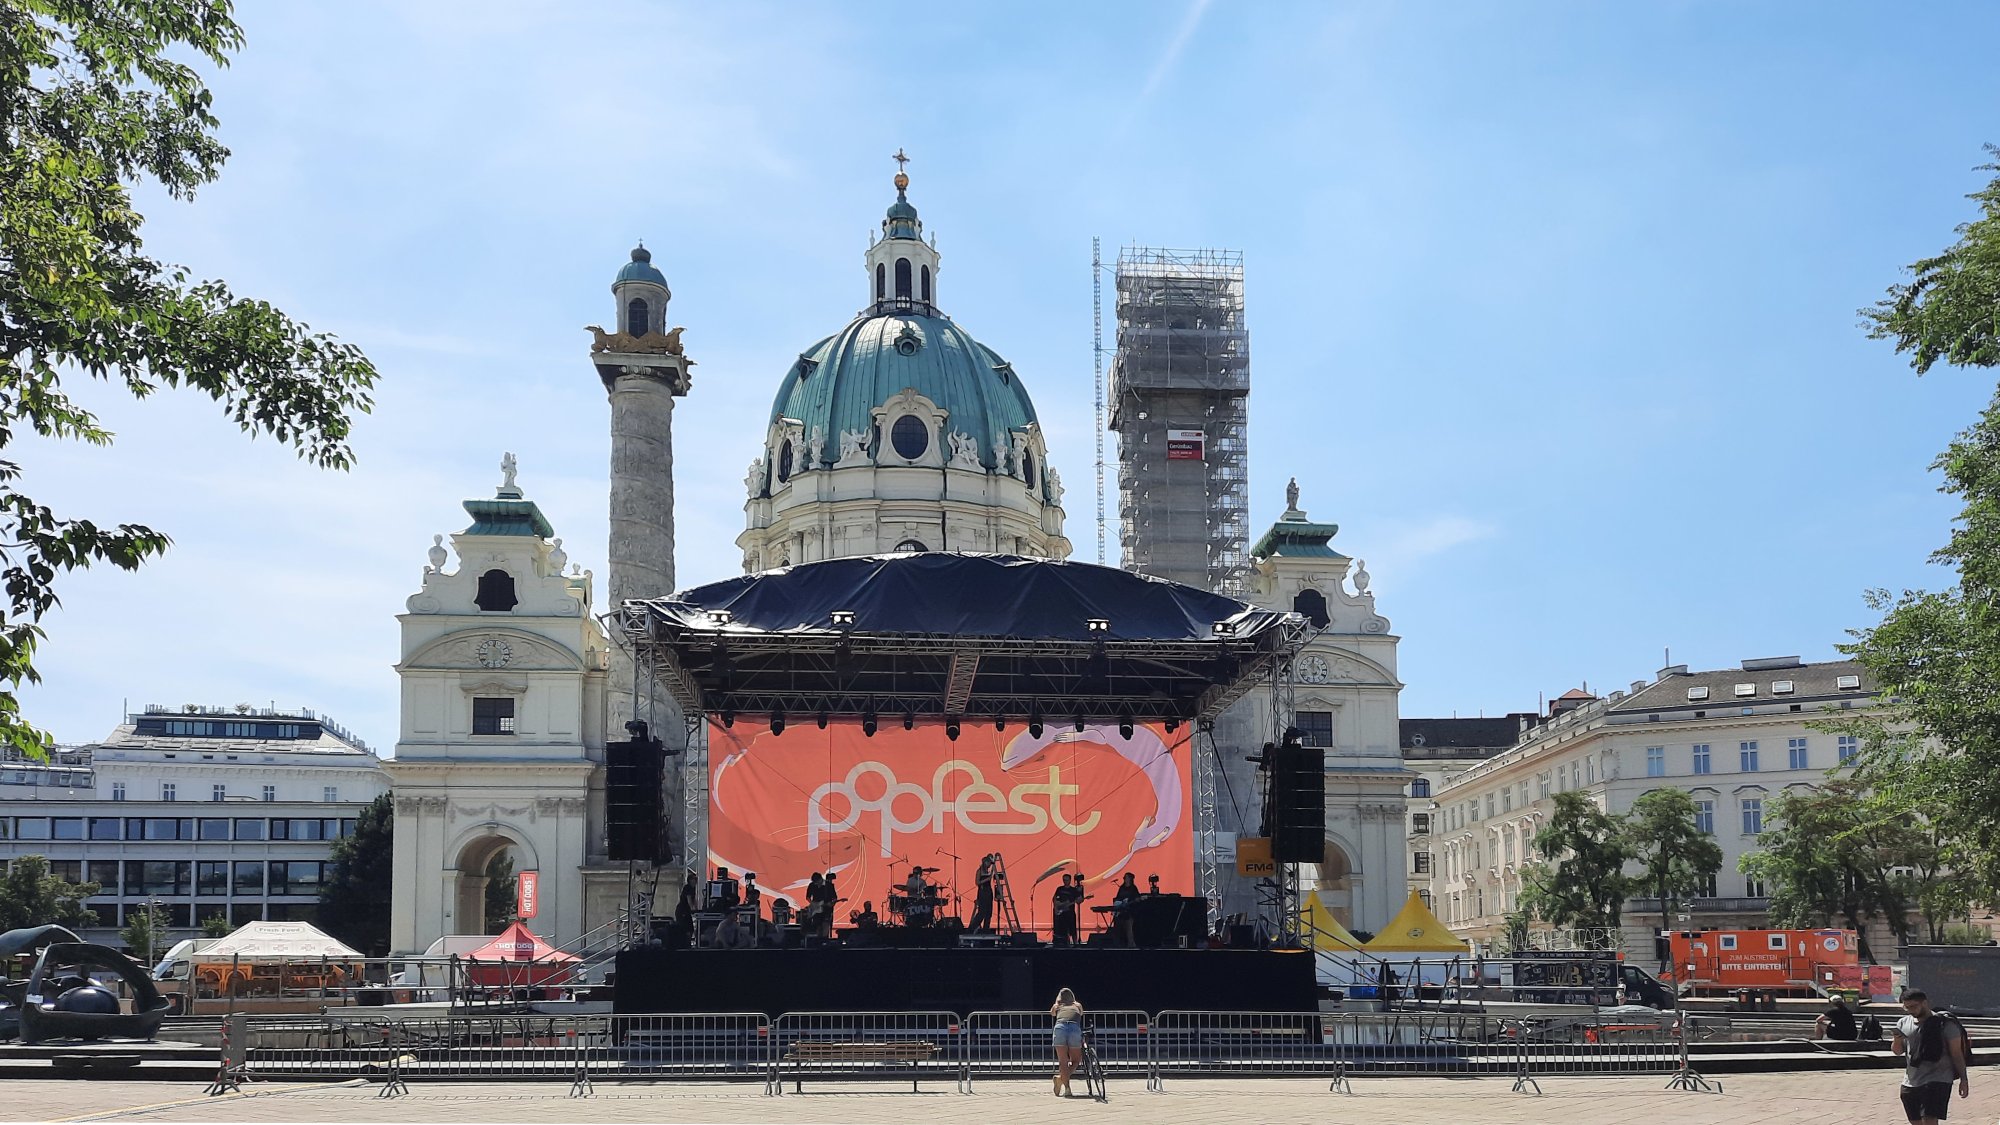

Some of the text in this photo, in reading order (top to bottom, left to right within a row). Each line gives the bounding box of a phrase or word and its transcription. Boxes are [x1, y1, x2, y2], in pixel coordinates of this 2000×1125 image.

[807, 760, 1101, 858] popfest
[1245, 863, 1274, 872] FM4
[523, 880, 532, 912] HOT DOGS
